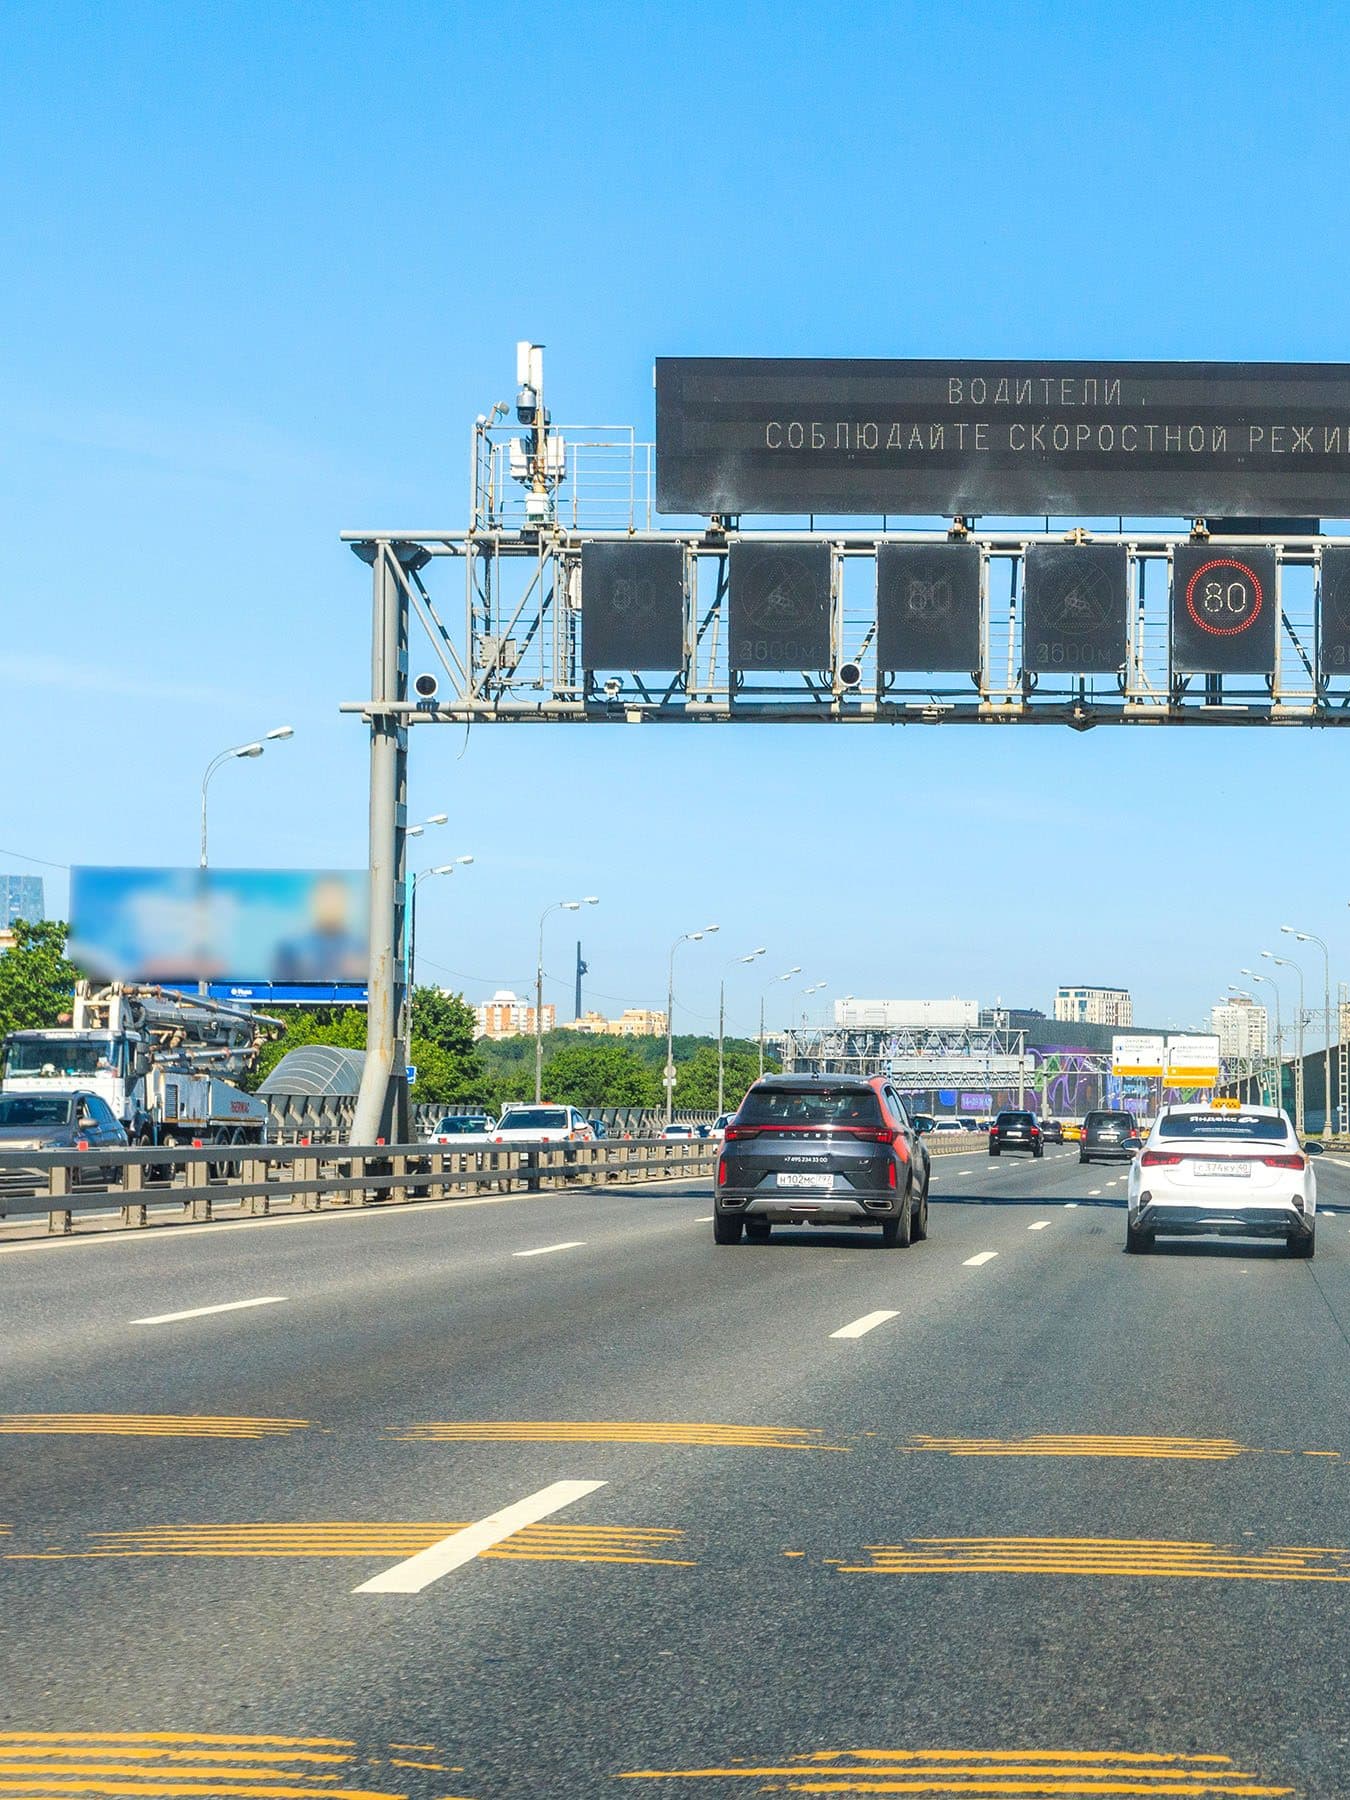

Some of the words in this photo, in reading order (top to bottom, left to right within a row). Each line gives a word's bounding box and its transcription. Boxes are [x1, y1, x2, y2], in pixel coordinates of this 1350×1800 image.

[948, 377, 1122, 406] ВОДИТЕЛИ
[765, 421, 990, 451] СОБЛЮДАЙТЕ
[1008, 423, 1227, 452] СКОРОСТНОЙ
[1203, 583, 1246, 613] 80
